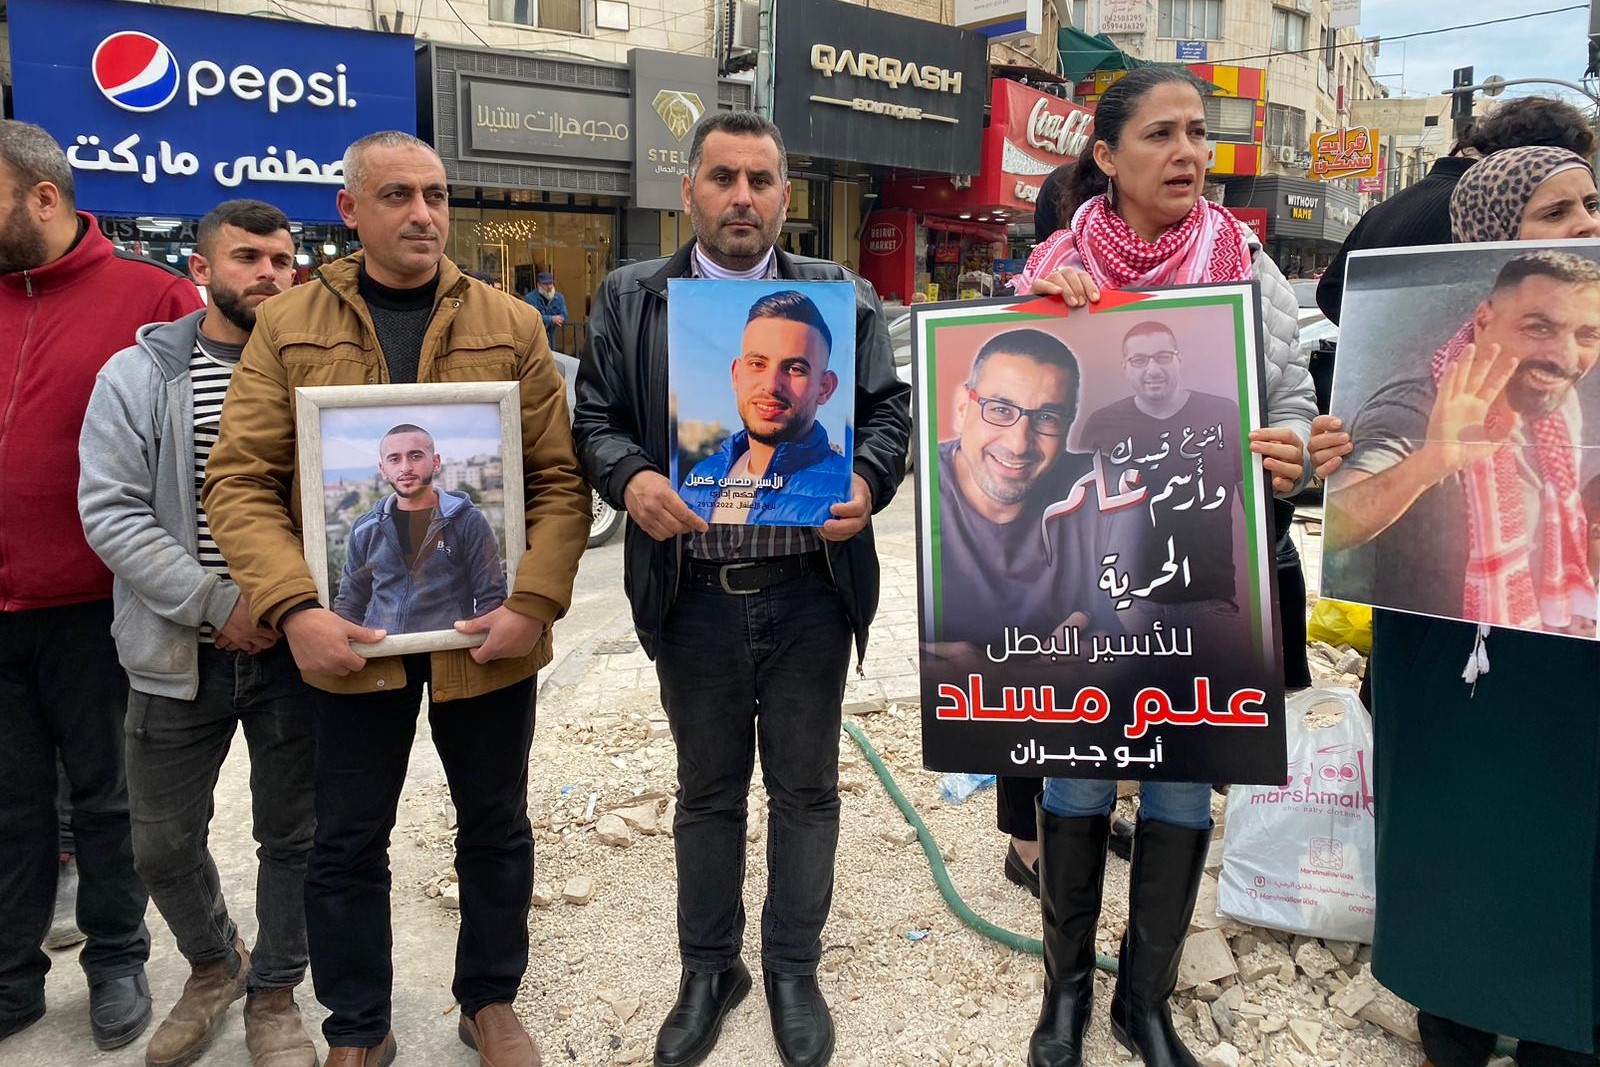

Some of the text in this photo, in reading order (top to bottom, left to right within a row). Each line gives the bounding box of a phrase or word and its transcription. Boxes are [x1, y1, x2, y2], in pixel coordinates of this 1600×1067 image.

[811, 44, 962, 94] QARQASH
[852, 98, 922, 119] BOUTIQUE
[477, 105, 629, 141] مجوهرات ستيلا
[66, 133, 345, 187] صطفى ماركت
[647, 148, 689, 165] STEL
[1287, 194, 1319, 209] WITHOUT
[1292, 208, 1313, 220] NAME
[870, 227, 896, 238] BEIRUT
[869, 240, 897, 250] MARKET
[1109, 436, 1171, 470] قيدك
[684, 472, 783, 490] الأسير محسن كميل
[1041, 449, 1149, 567] علم
[1098, 534, 1192, 611] الحرية
[986, 621, 1193, 664] للأسير البطل
[935, 673, 1269, 738] علم مساد
[1009, 736, 1164, 768] أبو جبران
[1303, 806, 1323, 814] baby
[1300, 867, 1340, 878] Marshmallow
[1259, 892, 1301, 903] Marshmallow
